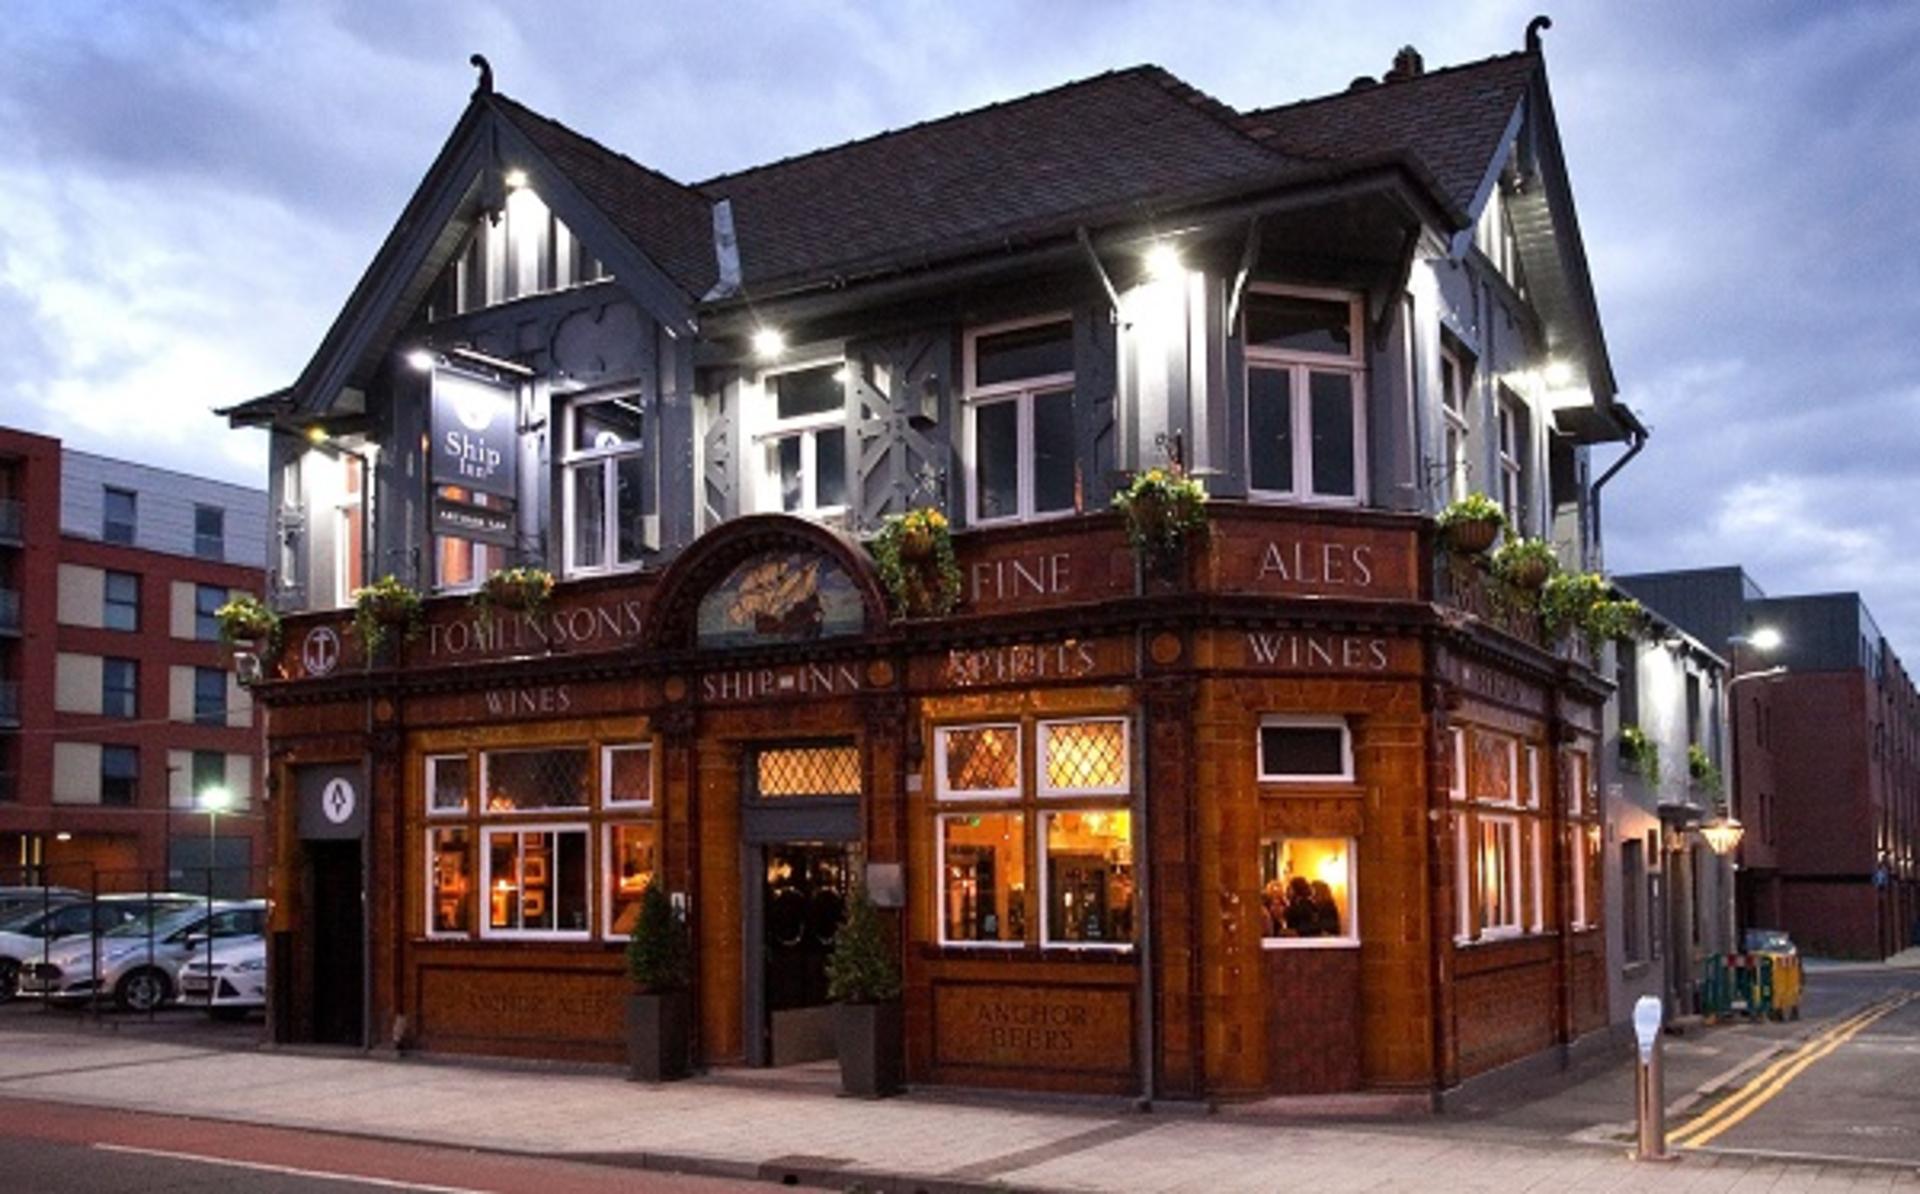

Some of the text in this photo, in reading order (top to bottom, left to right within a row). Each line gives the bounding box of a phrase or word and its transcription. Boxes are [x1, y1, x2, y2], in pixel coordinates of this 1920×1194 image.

[444, 431, 501, 474] Ship
[971, 553, 1070, 601] FINE
[1258, 541, 1372, 587] ALES
[948, 640, 1096, 682] SPIRITS
[1247, 631, 1387, 670] WINES
[485, 685, 571, 715] WINES
[703, 662, 860, 701] SHIP INN
[977, 1003, 1088, 1025] ANCHOR
[990, 1027, 1075, 1051] BEERS
